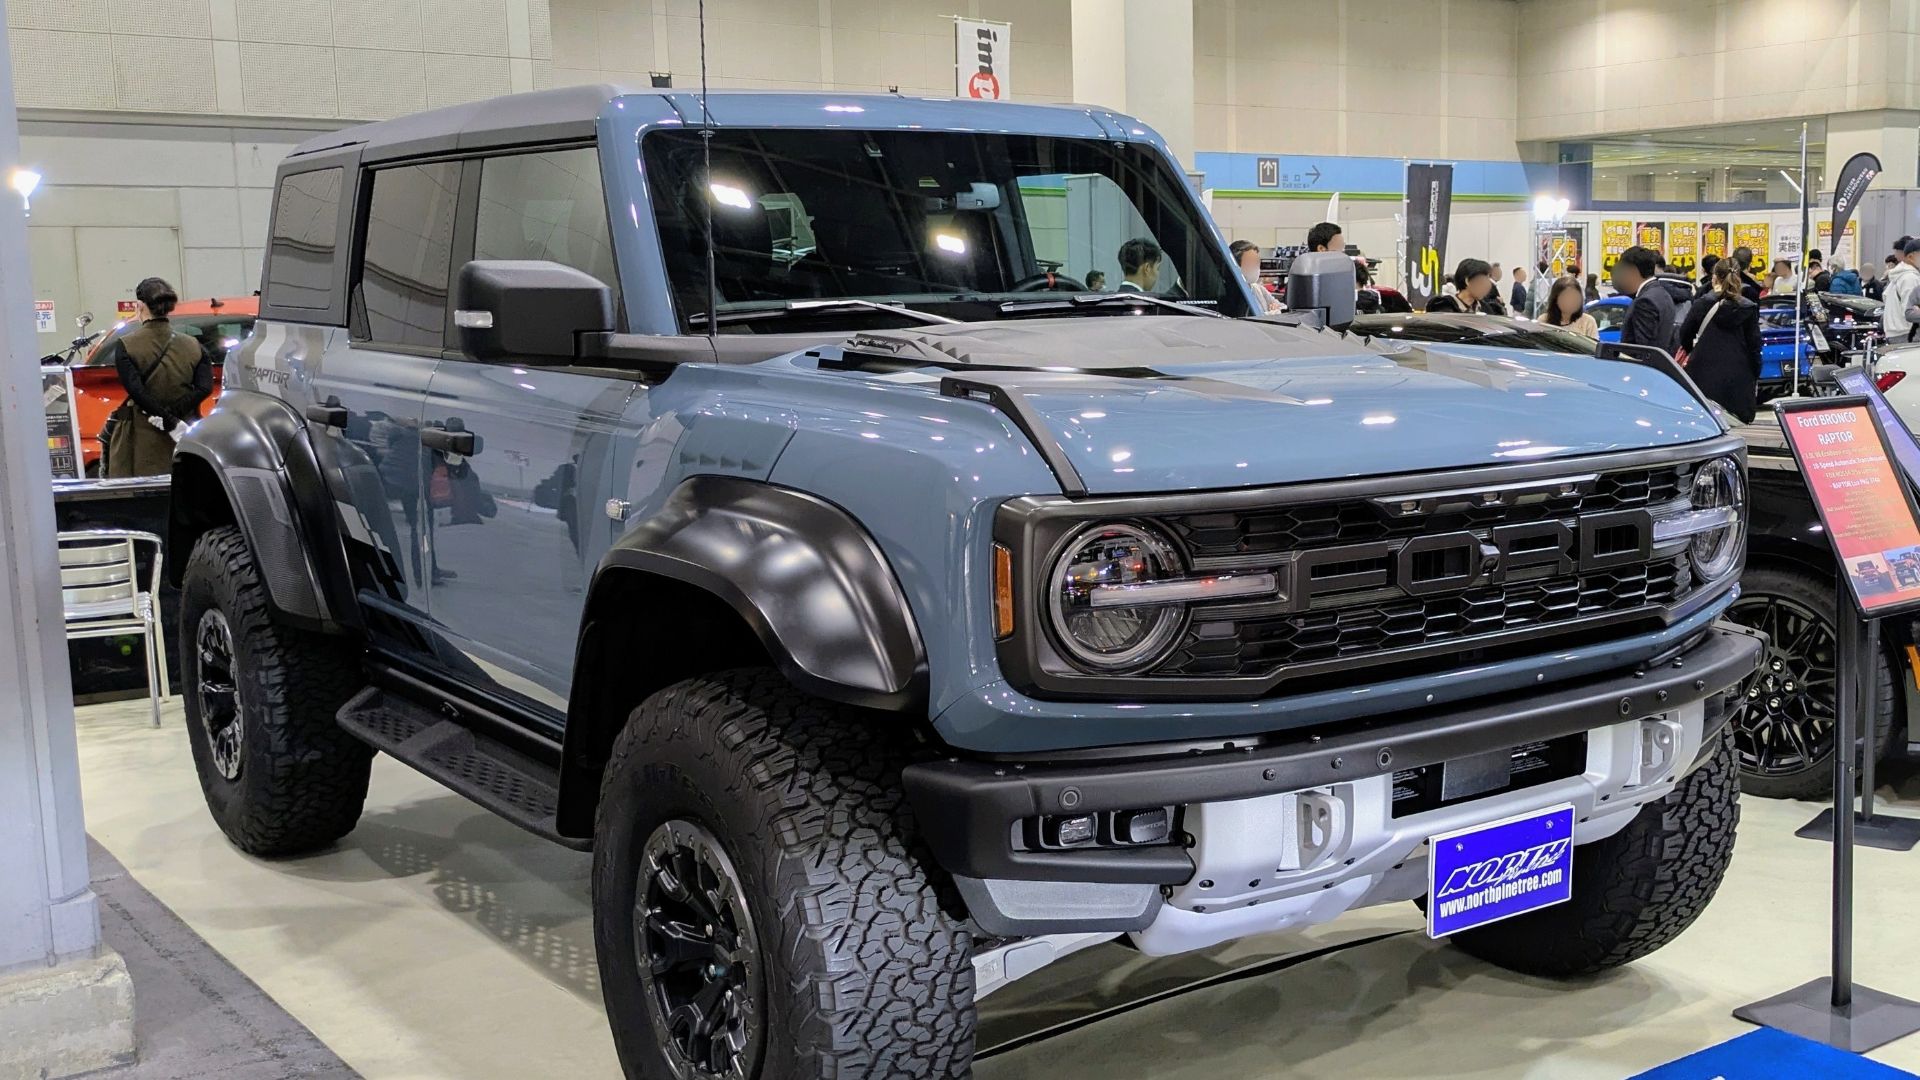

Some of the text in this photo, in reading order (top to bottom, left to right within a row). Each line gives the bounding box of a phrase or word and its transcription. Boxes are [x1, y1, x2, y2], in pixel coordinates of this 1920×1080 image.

[249, 367, 290, 390] RAPTOR
[1797, 411, 1857, 427] Ford BRONCO
[1818, 432, 1854, 445] RAPTOR
[1291, 507, 1653, 612] FORD
[1440, 868, 1563, 918] www.northpinetree.com
